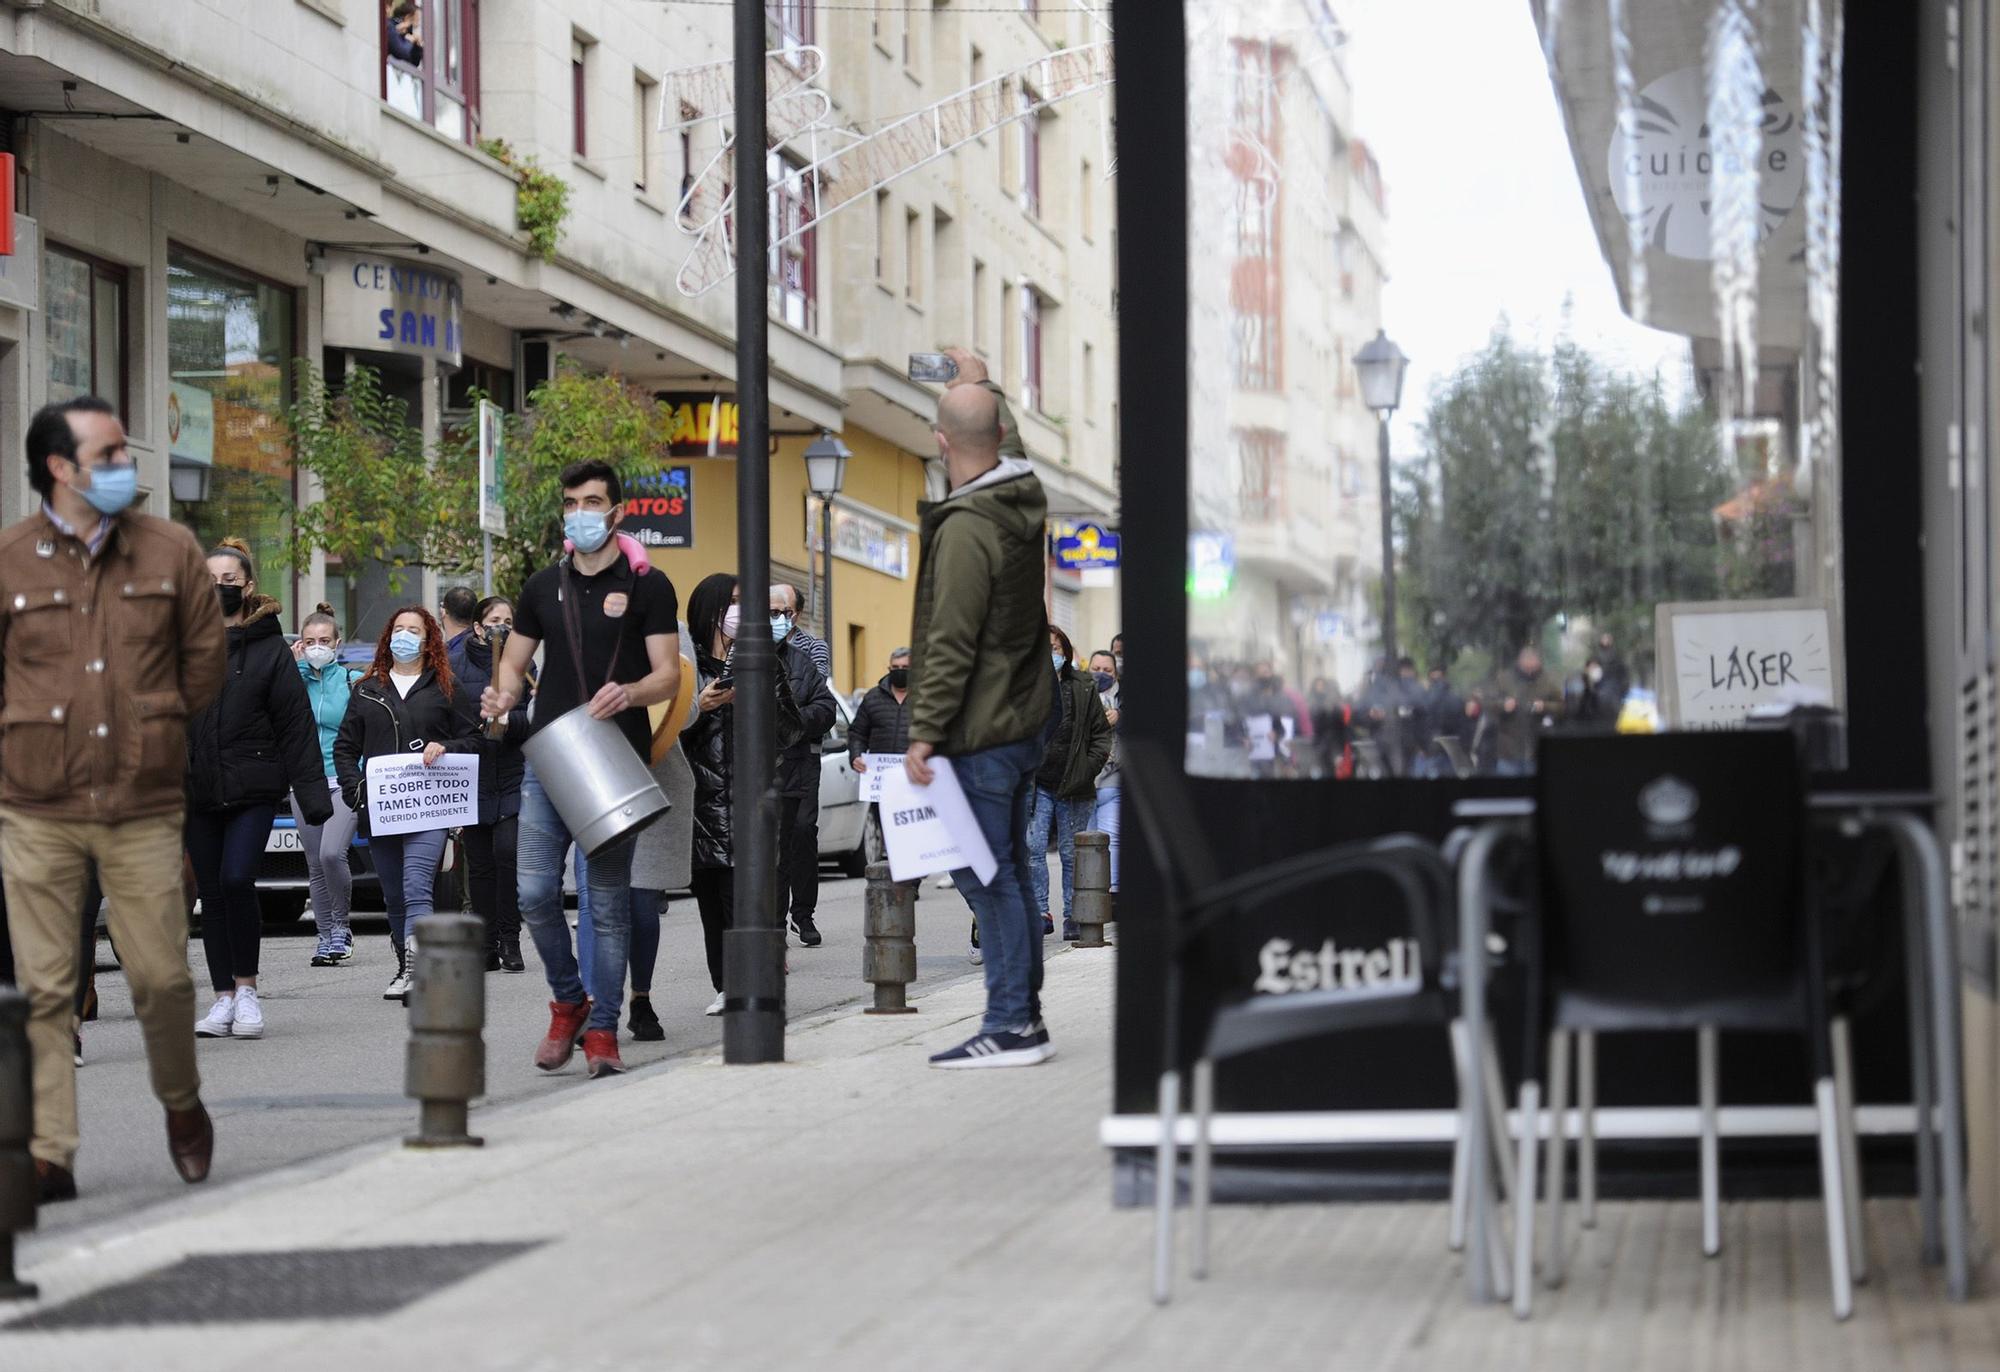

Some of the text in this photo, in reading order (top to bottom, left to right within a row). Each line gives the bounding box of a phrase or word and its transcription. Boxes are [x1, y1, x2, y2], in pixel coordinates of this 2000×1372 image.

[353, 262, 440, 299] CENTRO
[379, 309, 435, 347] SAN
[624, 497, 685, 516] ATOS
[1709, 645, 1801, 691] LÁSER
[379, 780, 470, 795] E SOBRE TODO
[377, 793, 468, 811] TAMÉN COMEN
[379, 806, 469, 825] QUERIDO PRESIDENTE
[893, 806, 936, 826] ESTAM
[1253, 937, 1421, 994] Estrell
